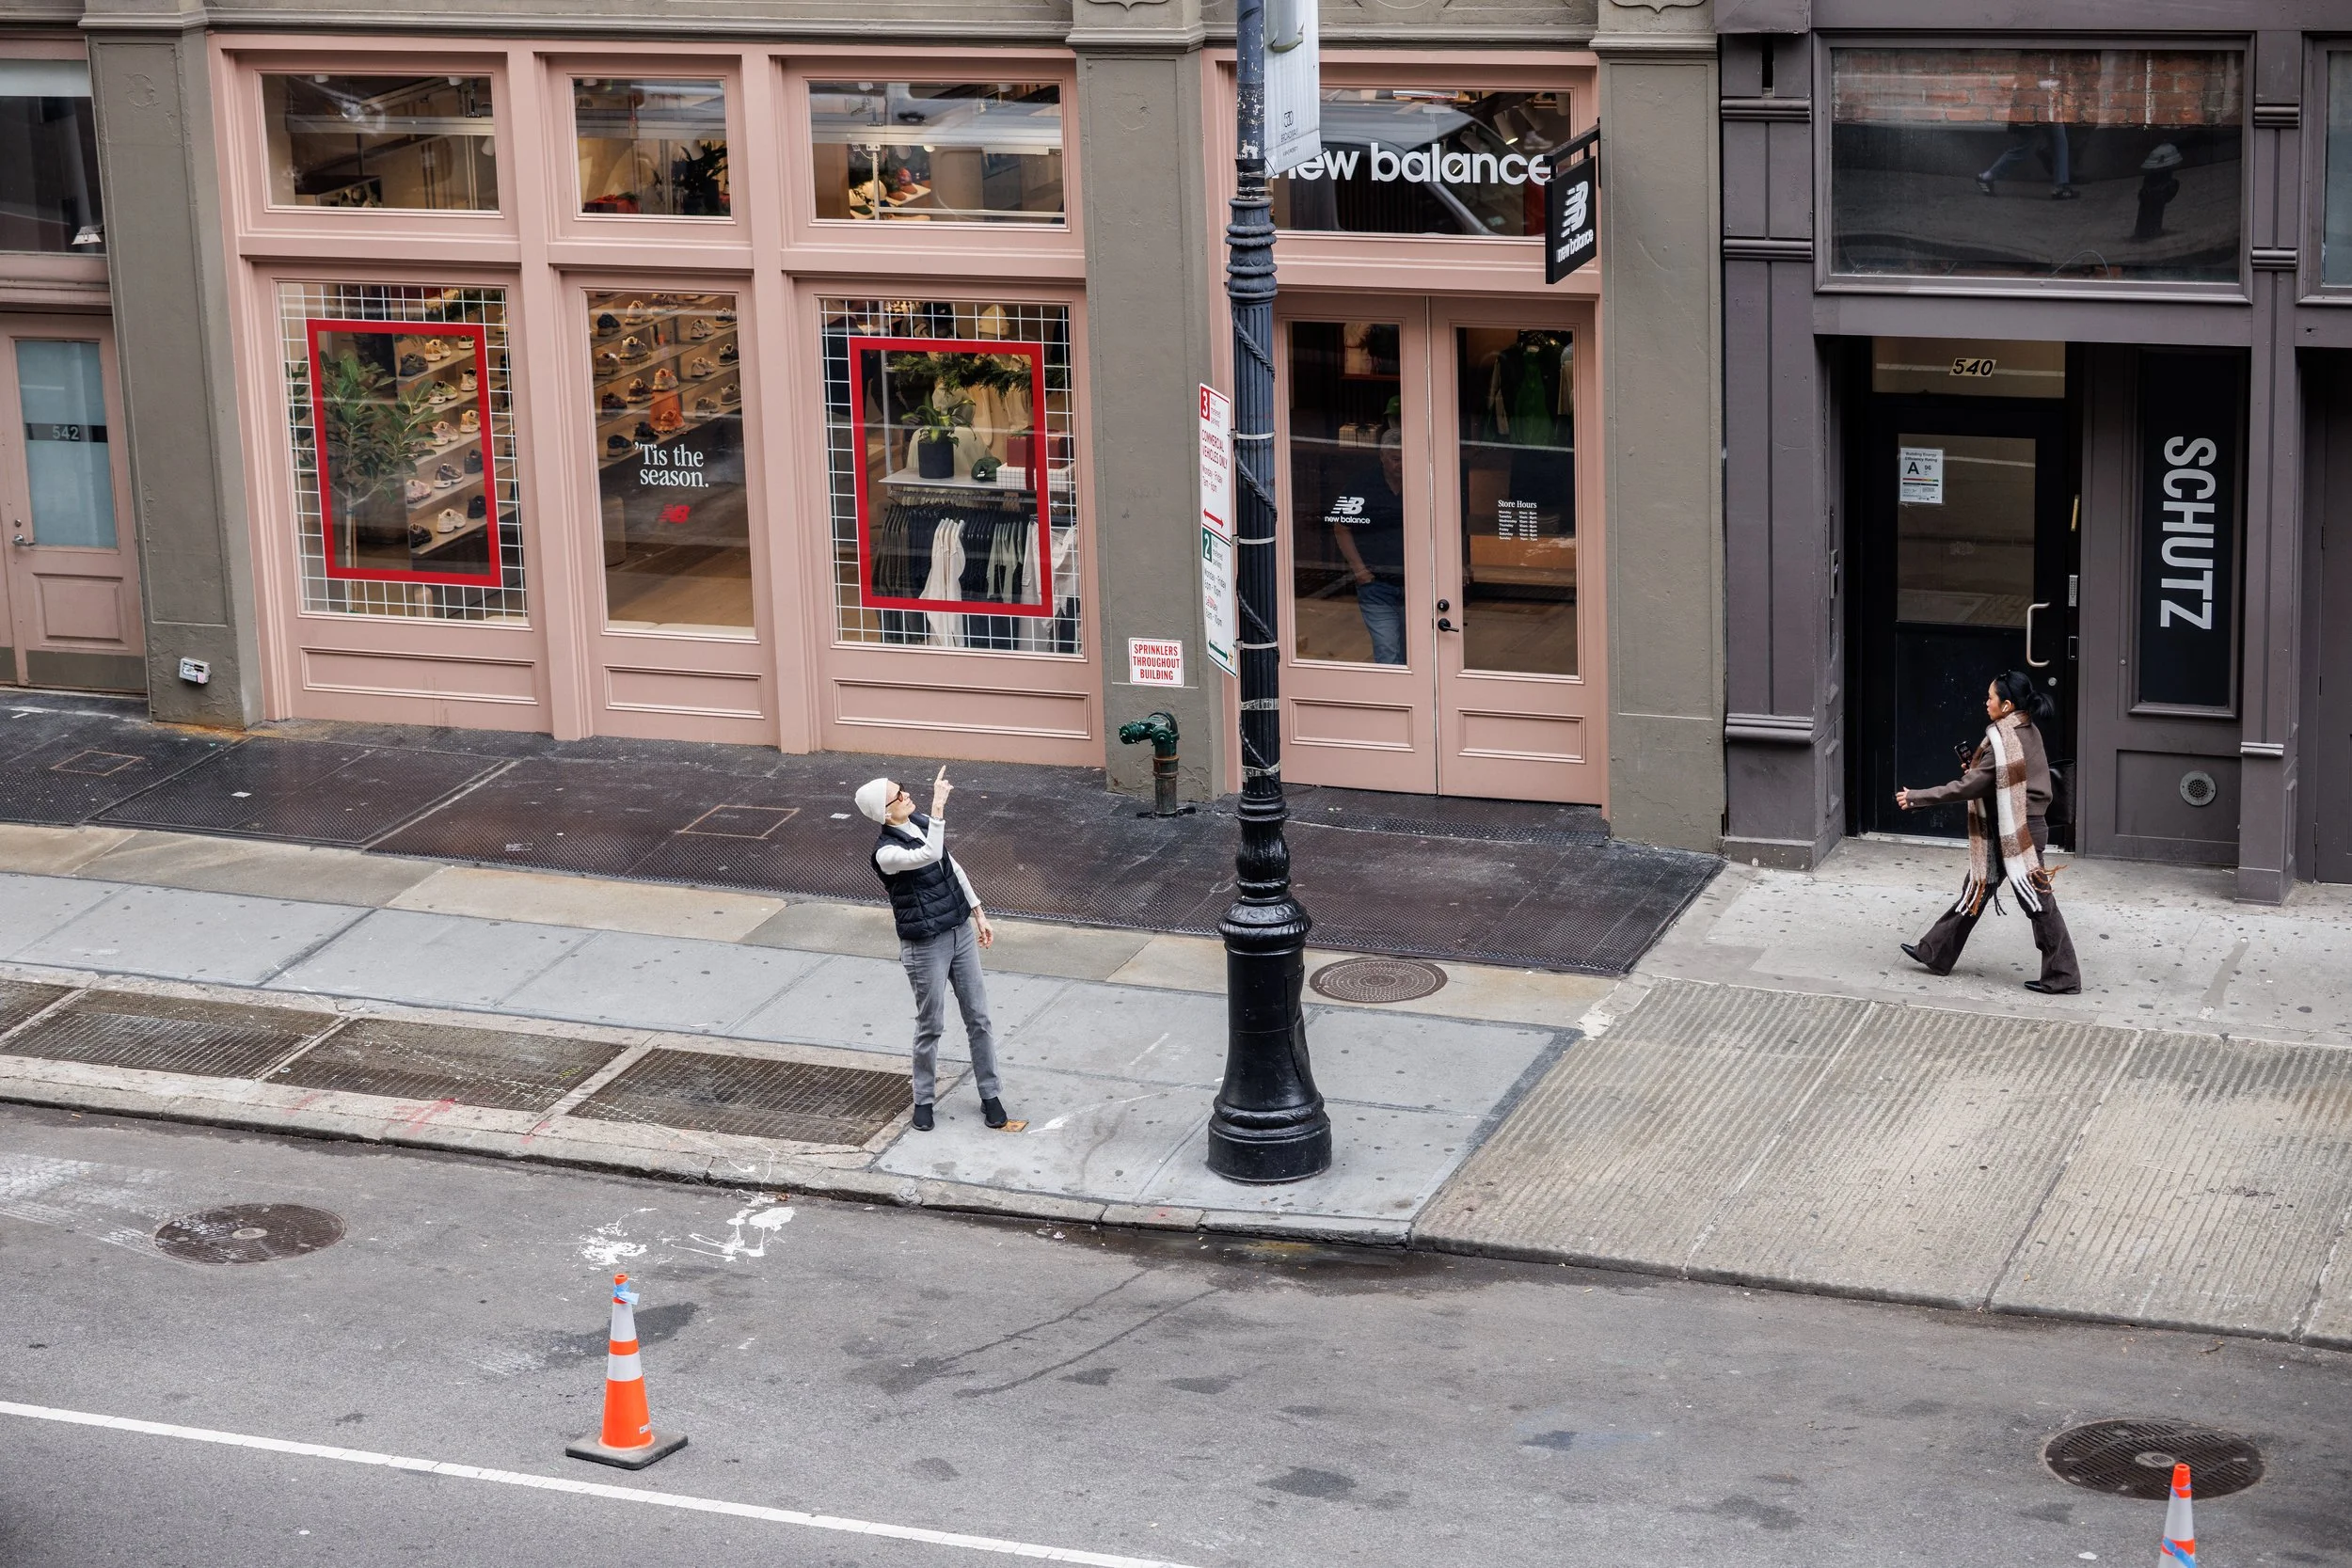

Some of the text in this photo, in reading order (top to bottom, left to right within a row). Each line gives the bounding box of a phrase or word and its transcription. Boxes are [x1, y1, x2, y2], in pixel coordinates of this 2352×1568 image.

[1272, 142, 1551, 186] ew balance
[1556, 229, 1594, 262] new balance
[1952, 358, 1994, 376] 540
[1202, 390, 1208, 418] 3
[52, 425, 80, 440] 542
[1202, 429, 1224, 452] COMMERCIAL
[673, 443, 705, 467] the
[1202, 444, 1228, 469] VEHICLES ONLY
[640, 468, 709, 488] season.
[1907, 462, 1919, 474] A
[1498, 499, 1537, 509] Store Hours
[1341, 515, 1371, 524] balance
[2160, 436, 2217, 630] SCHUTZ
[1204, 532, 1211, 560] 2
[1134, 643, 1178, 657] SPRINKLERS
[1133, 656, 1181, 669] THROUGHOUT
[1139, 668, 1174, 680] BUILDING
